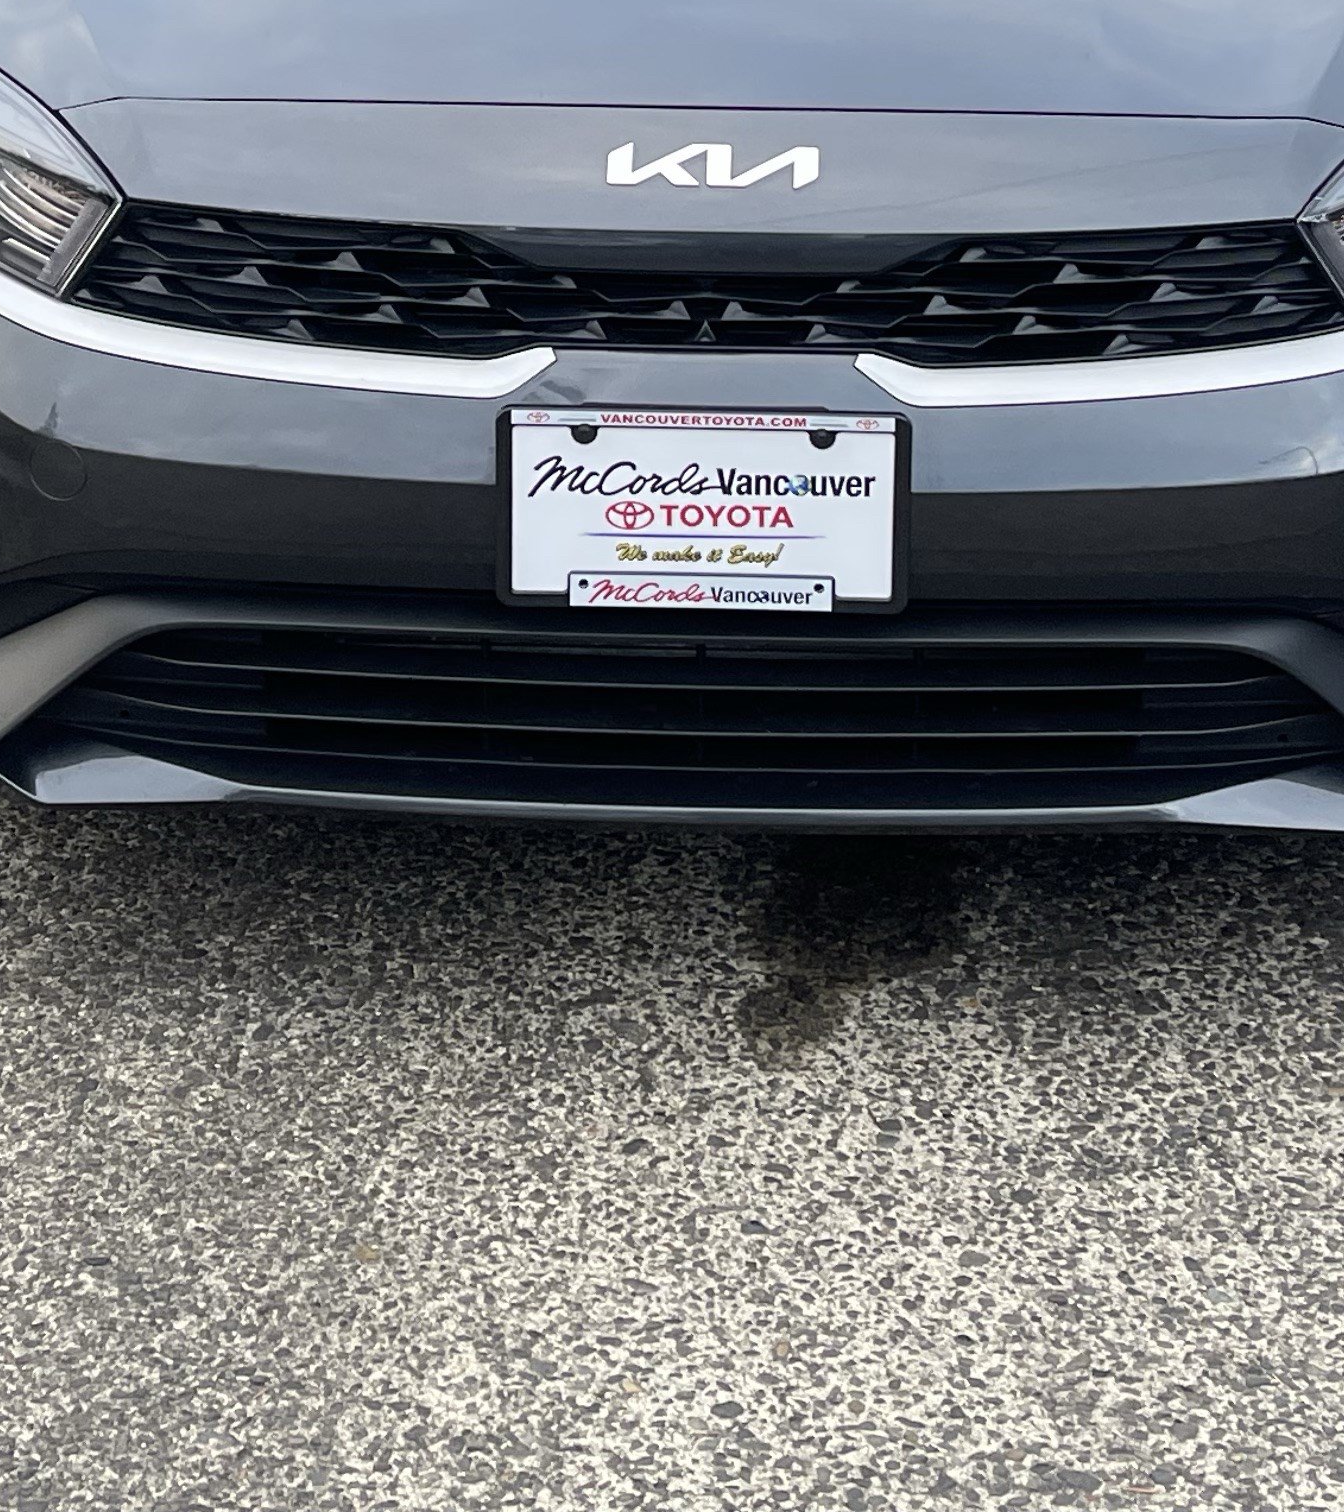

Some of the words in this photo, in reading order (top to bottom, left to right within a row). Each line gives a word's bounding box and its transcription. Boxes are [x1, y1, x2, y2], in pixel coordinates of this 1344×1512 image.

[600, 413, 807, 428] VANCOUVERTOYOTA.COM
[716, 467, 876, 498] Vancouver
[660, 504, 794, 528] TOYOTA
[616, 542, 648, 562] We
[652, 544, 702, 562] make
[706, 548, 723, 563] it
[727, 542, 785, 568] Easy!
[710, 586, 813, 605] Vancouver
